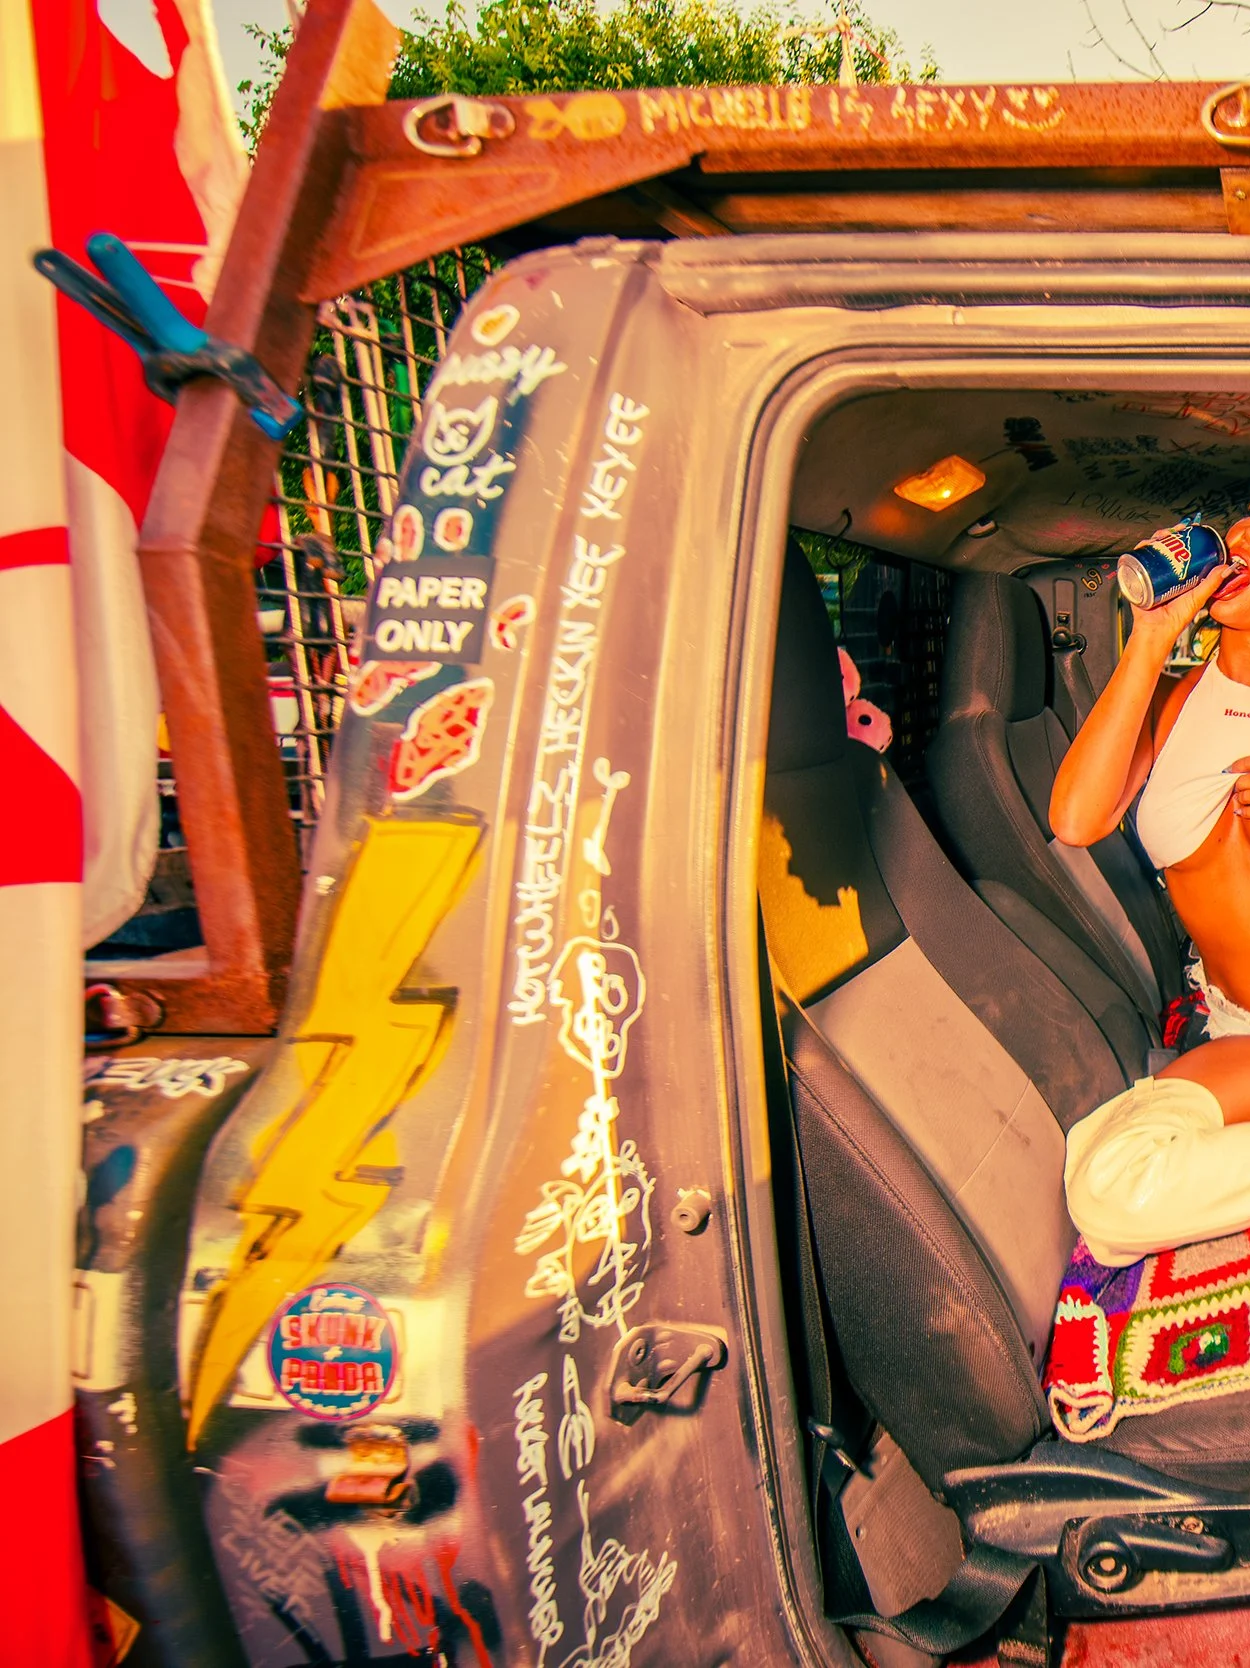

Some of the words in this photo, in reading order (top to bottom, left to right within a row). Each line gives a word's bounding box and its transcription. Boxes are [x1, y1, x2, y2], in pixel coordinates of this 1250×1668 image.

[420, 452, 517, 499] cat
[376, 574, 488, 609] PAPER
[375, 618, 475, 654] ONLY
